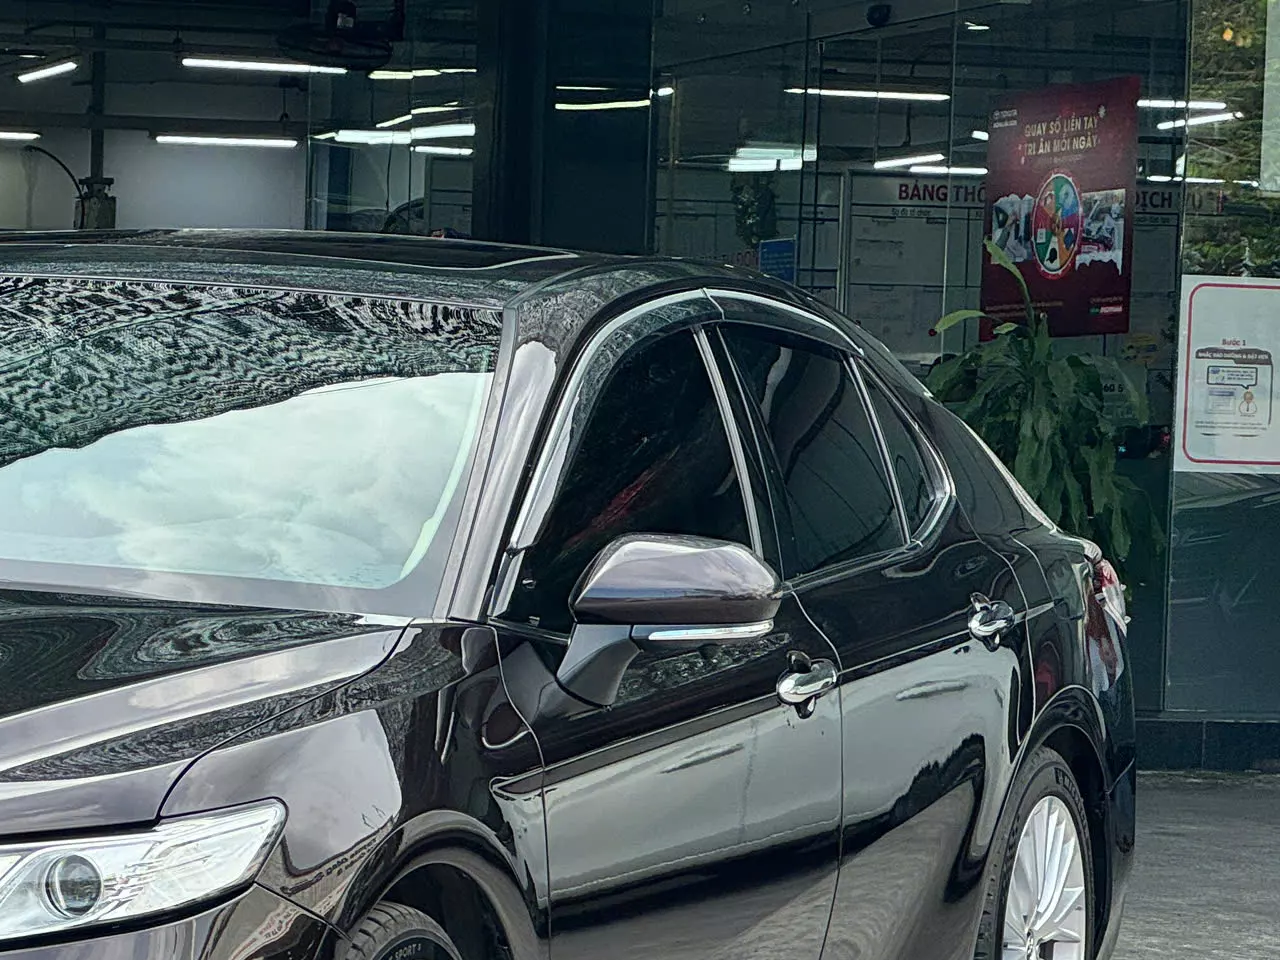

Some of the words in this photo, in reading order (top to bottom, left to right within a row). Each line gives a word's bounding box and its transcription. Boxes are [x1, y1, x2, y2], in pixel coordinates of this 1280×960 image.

[1024, 122, 1046, 137] QUAY
[1084, 116, 1098, 129] TAY
[1039, 138, 1051, 154] ÂN
[1073, 132, 1097, 150] NGÀY
[898, 179, 949, 201] BẢNG
